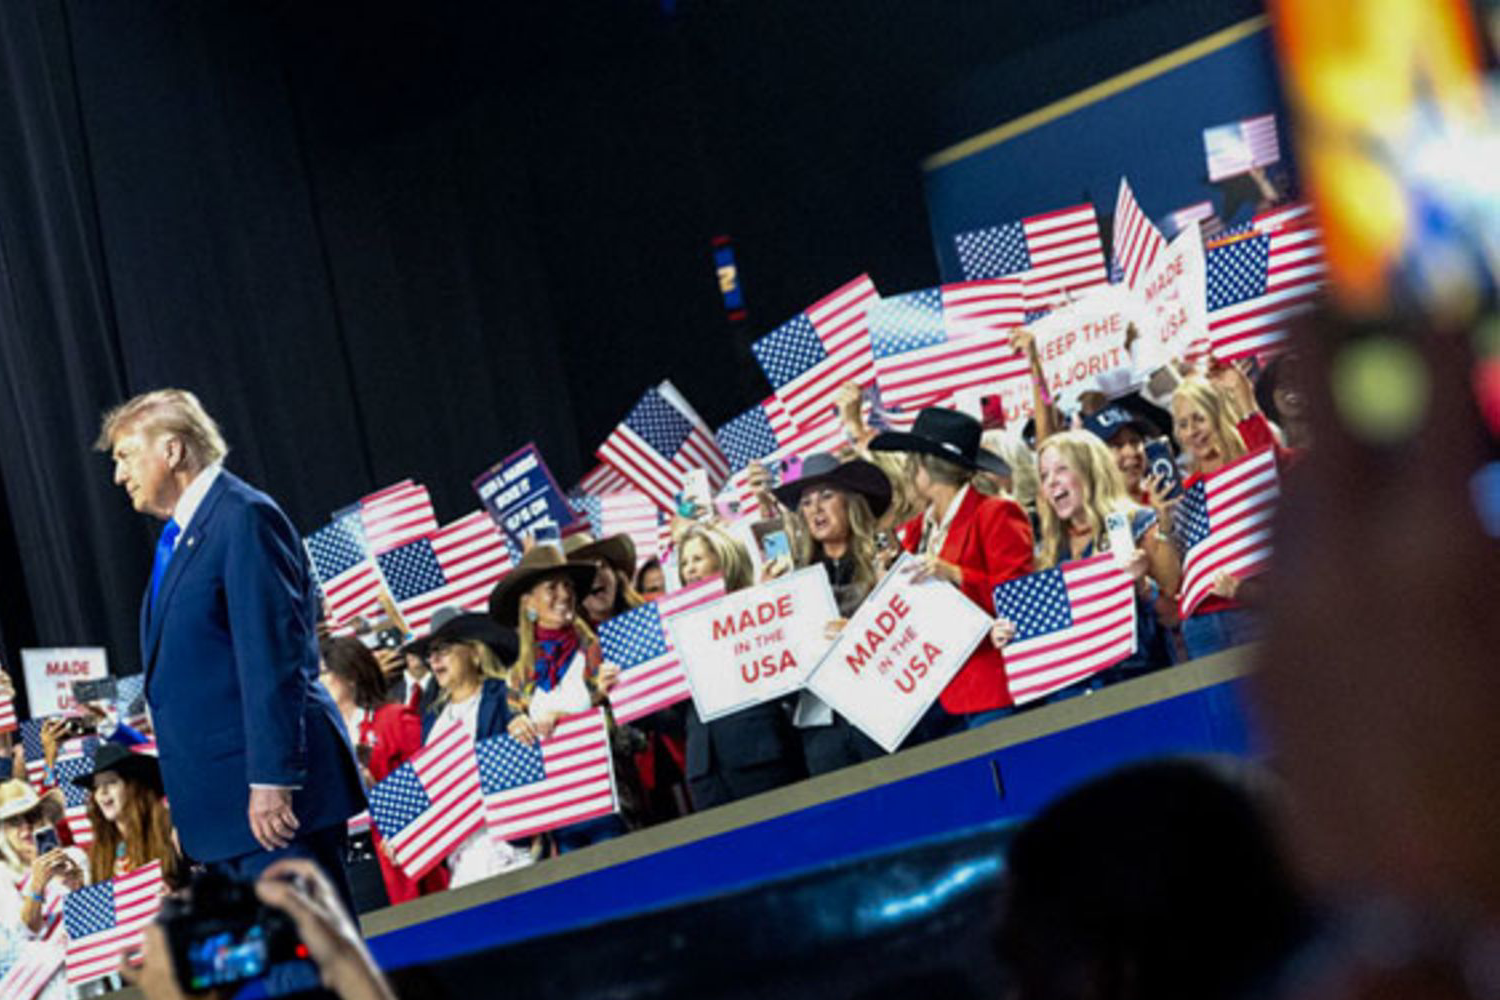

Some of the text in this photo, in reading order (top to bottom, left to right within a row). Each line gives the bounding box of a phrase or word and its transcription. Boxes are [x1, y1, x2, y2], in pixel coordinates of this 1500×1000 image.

[1040, 312, 1122, 361] EEP THE
[1160, 308, 1188, 343] USA
[1050, 347, 1122, 390] AJORIT
[1003, 400, 1036, 423] US
[712, 594, 794, 640] MADE
[845, 593, 911, 674] MADE
[733, 628, 784, 656] IN THE
[876, 626, 918, 675] IN THE
[45, 660, 90, 677] MADE
[741, 649, 798, 684] USA
[894, 641, 943, 694] USA
